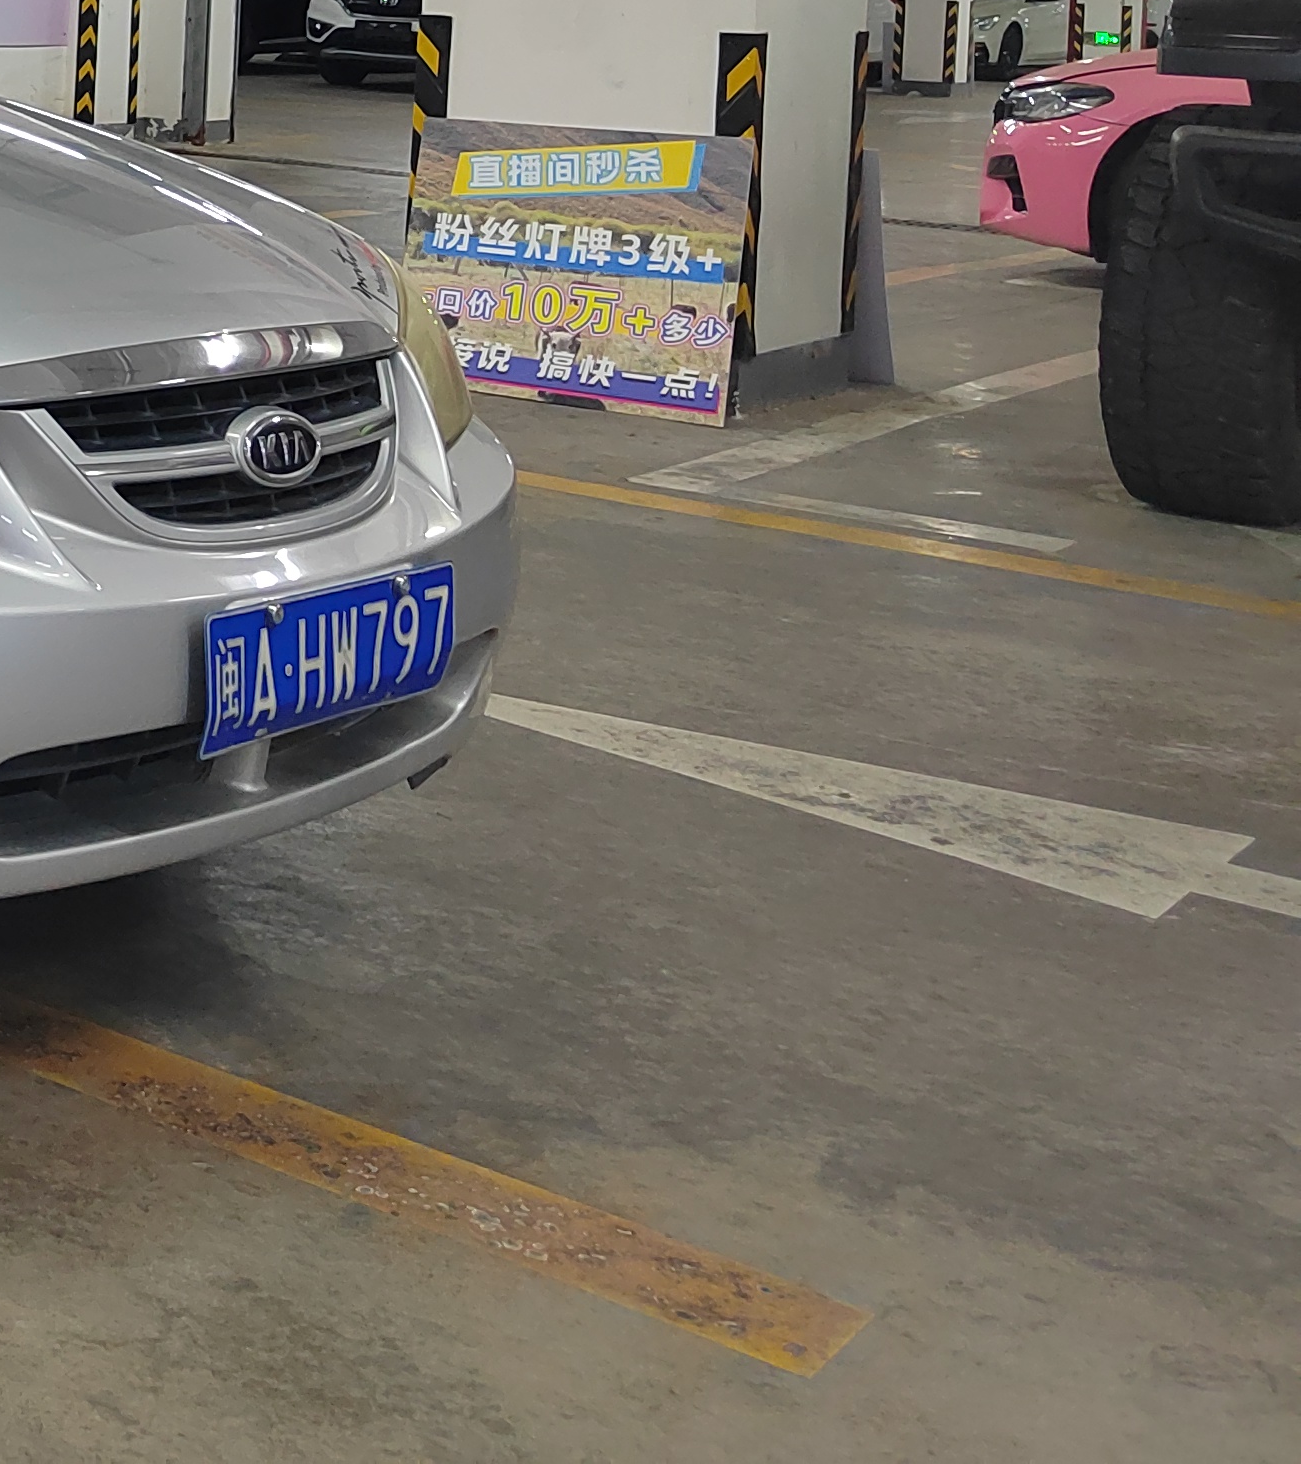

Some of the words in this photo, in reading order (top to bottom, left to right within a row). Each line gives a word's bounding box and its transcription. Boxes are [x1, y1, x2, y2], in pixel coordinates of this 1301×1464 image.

[469, 148, 662, 188] 直播间秒杀
[432, 212, 722, 275] 粉丝灯牌3级+
[212, 585, 449, 737] 闽A·HW797
